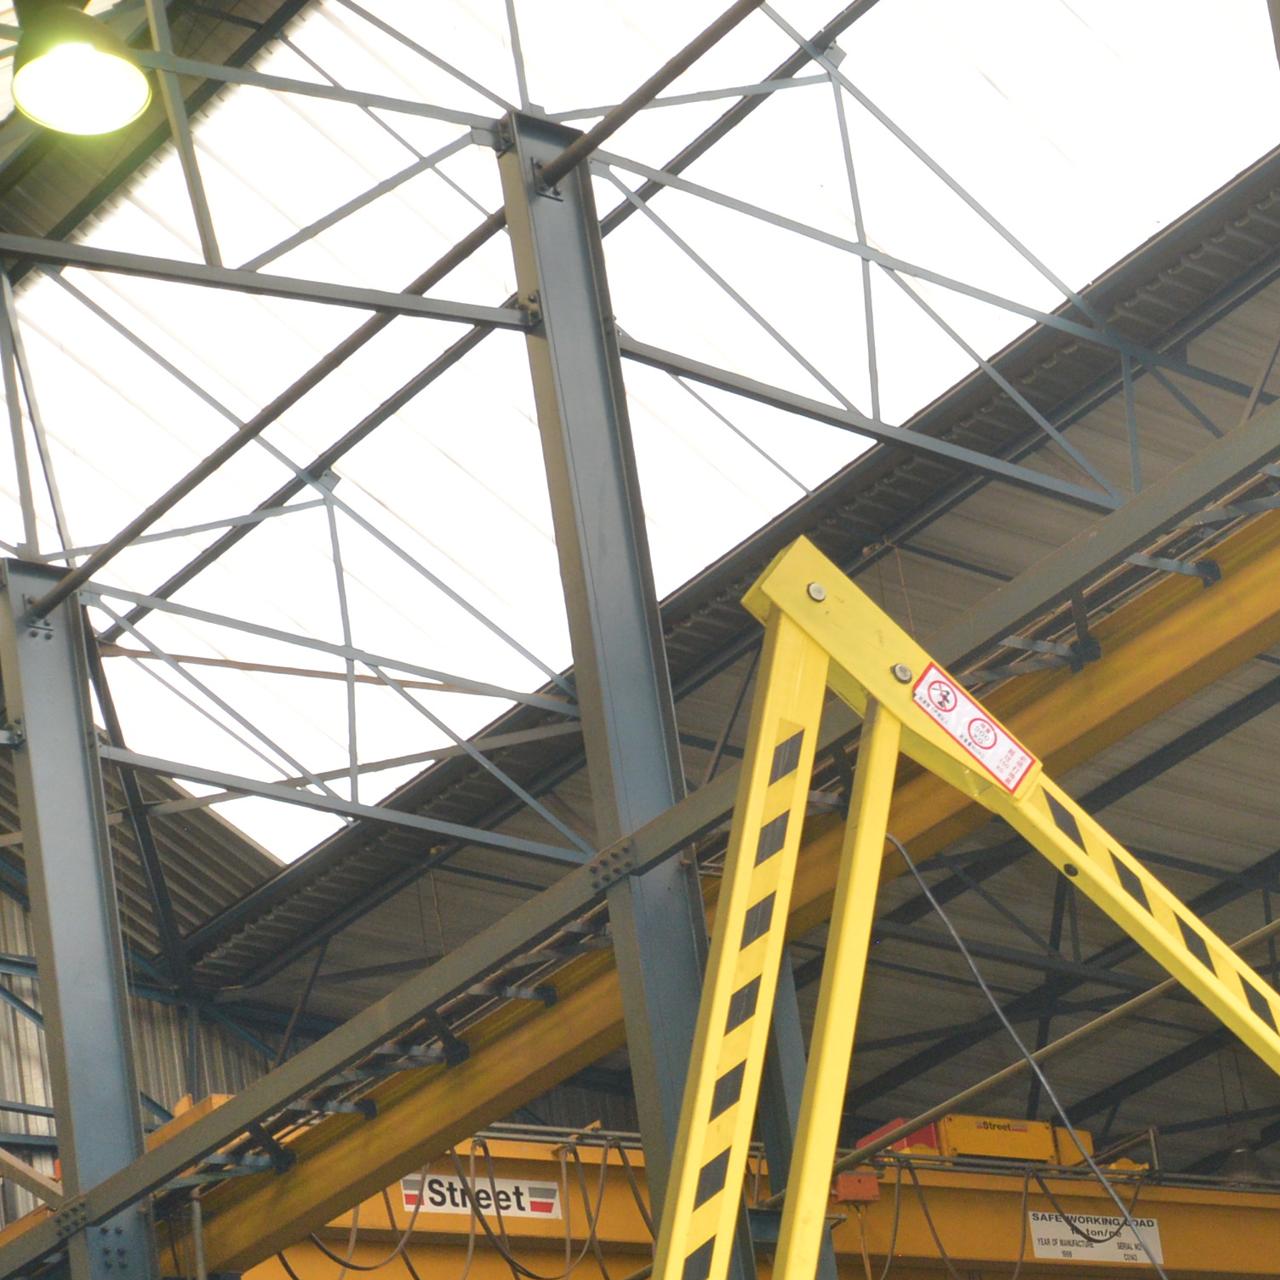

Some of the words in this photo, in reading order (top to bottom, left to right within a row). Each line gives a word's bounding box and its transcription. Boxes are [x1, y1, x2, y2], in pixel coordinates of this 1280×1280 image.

[428, 1179, 526, 1211] Street
[1032, 1213, 1063, 1223] SAFE
[1067, 1215, 1120, 1226] WORKING
